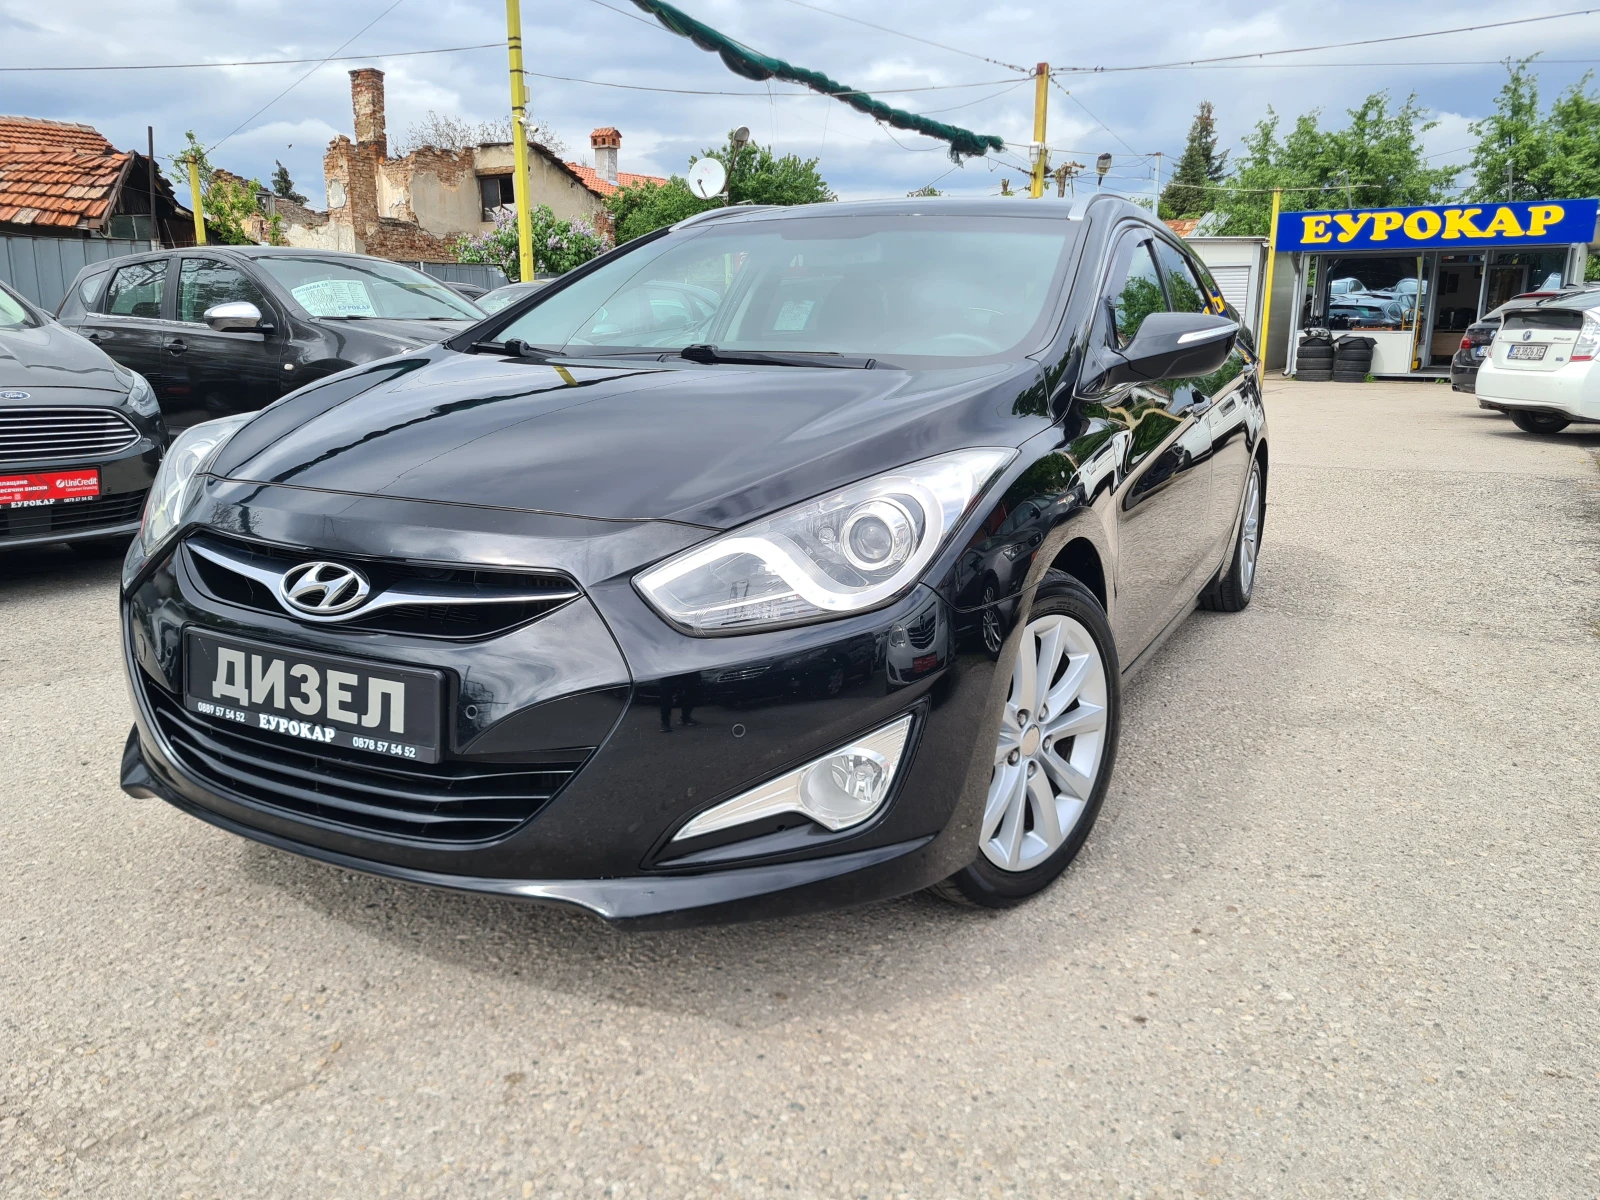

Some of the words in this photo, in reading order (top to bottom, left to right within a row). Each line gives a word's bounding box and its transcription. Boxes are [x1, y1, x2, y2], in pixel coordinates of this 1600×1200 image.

[1300, 205, 1565, 244] ЕУРОКАР
[65, 477, 98, 486] UniCredit
[11, 498, 55, 508] ЕУРОКАР
[212, 646, 405, 734] ДИЗЕЛ
[198, 702, 214, 714] 0889
[216, 706, 224, 716] 57
[226, 709, 235, 720] 54
[236, 711, 245, 722] 52
[258, 714, 336, 743] ЕУРОКАР
[352, 737, 375, 750] 0878
[377, 741, 388, 752] 57
[390, 744, 402, 755] 54
[404, 746, 415, 758] 52
